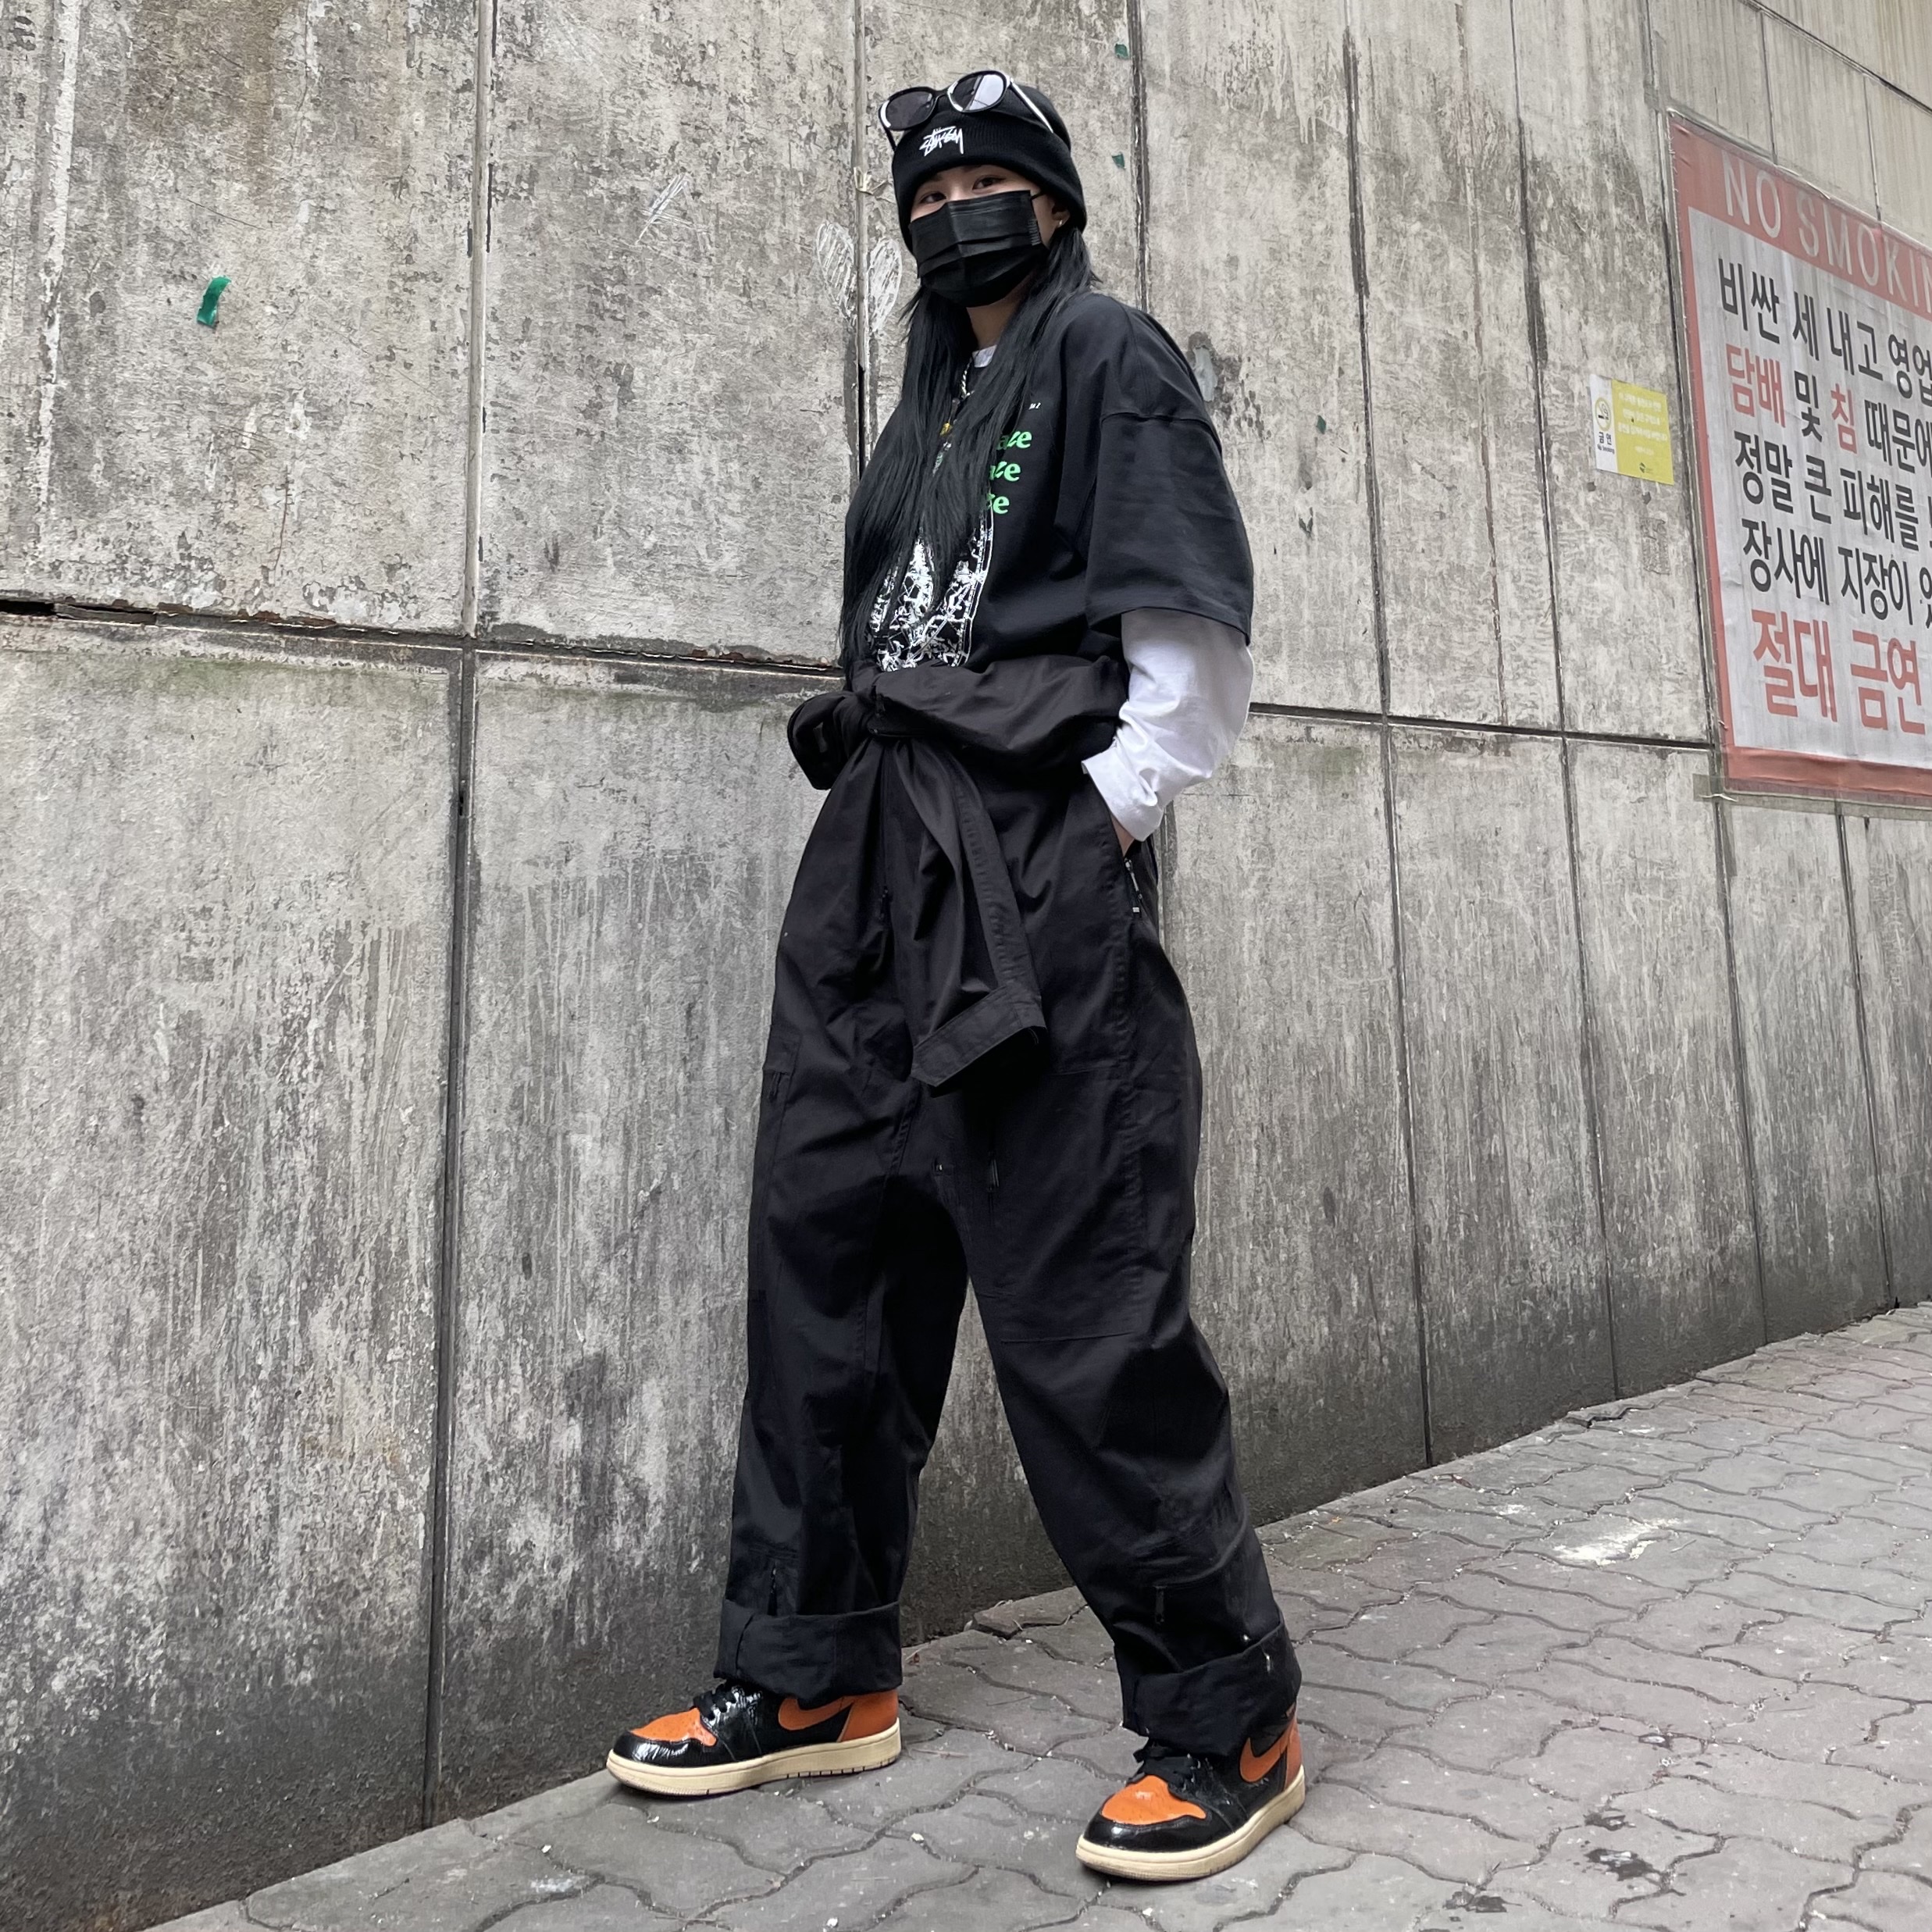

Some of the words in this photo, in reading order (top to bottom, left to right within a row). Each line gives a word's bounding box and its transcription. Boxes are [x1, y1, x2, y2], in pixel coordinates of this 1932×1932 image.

[1723, 153, 1781, 238] NO
[1719, 258, 1781, 344] 비싼
[1792, 291, 1820, 362] 세
[1827, 307, 1884, 382] 내고
[1726, 343, 1786, 429] 담배
[1794, 370, 1823, 443] 및
[1830, 383, 1858, 454] 침
[1734, 430, 1793, 514] 정말
[1804, 454, 1832, 524] 큰
[1840, 467, 1919, 551] 피해를
[1741, 517, 1830, 606] 장사에
[1838, 546, 1913, 626] 지장이
[1751, 608, 1838, 722] 절대
[1850, 629, 1926, 736] 금연
